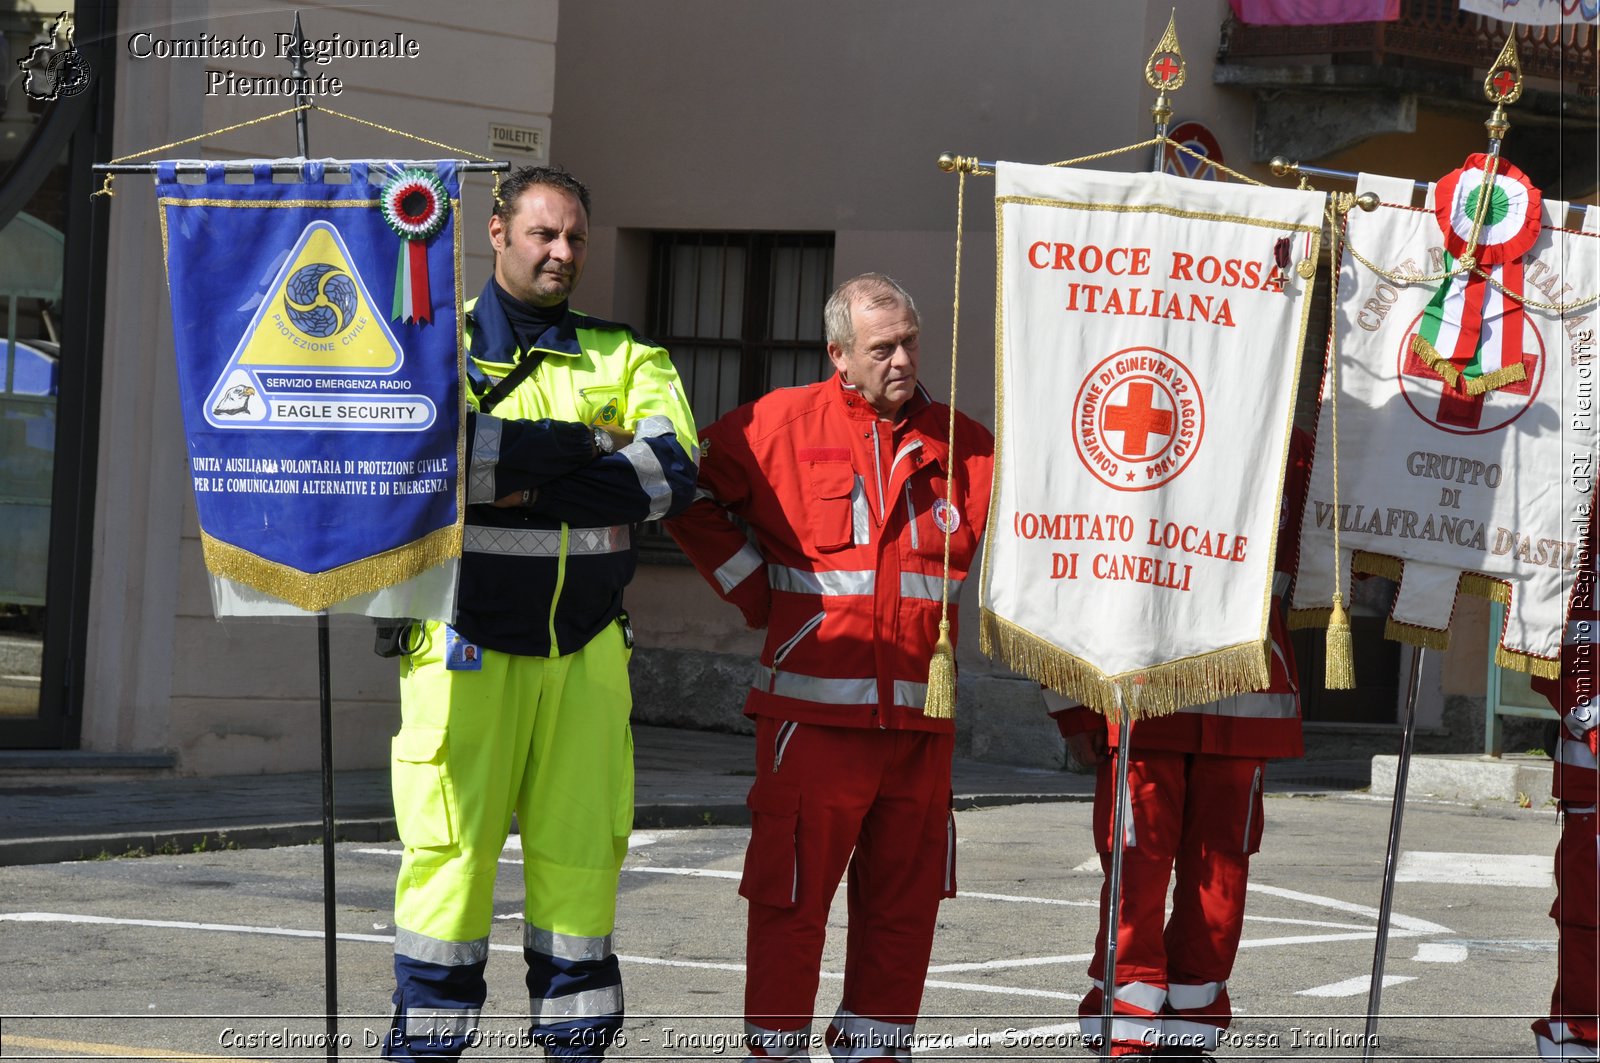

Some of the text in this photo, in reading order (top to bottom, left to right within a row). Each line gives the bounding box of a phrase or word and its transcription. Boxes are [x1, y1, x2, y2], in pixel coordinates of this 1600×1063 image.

[493, 127, 540, 145] TOILETTE
[1028, 241, 1151, 276] CROCE
[1065, 283, 1237, 328] ITALIANA
[272, 313, 367, 352] PROTEZIONE CIVILE
[266, 378, 412, 390] SERVIZIO EMERGENZA RADIO
[277, 405, 416, 419] EAGLE SECURITY
[1081, 356, 1196, 479] CONVENZIONE DI GINEVRA 22 AGOSTO 1864
[193, 457, 448, 475] UNITA' AUSILIARIA VOLONTARIA DI PROTEZIONE CIVILE
[1406, 450, 1503, 489] GRUPPO
[194, 477, 448, 495] PER LE COMUNICAZIONI ALTERNATIVE E DI EMERGENZA
[1438, 487, 1462, 509] DI
[1147, 518, 1248, 563] LOCALE
[1313, 500, 1488, 551] VILLAFRANCA
[1050, 552, 1193, 591] DI CANELLI
